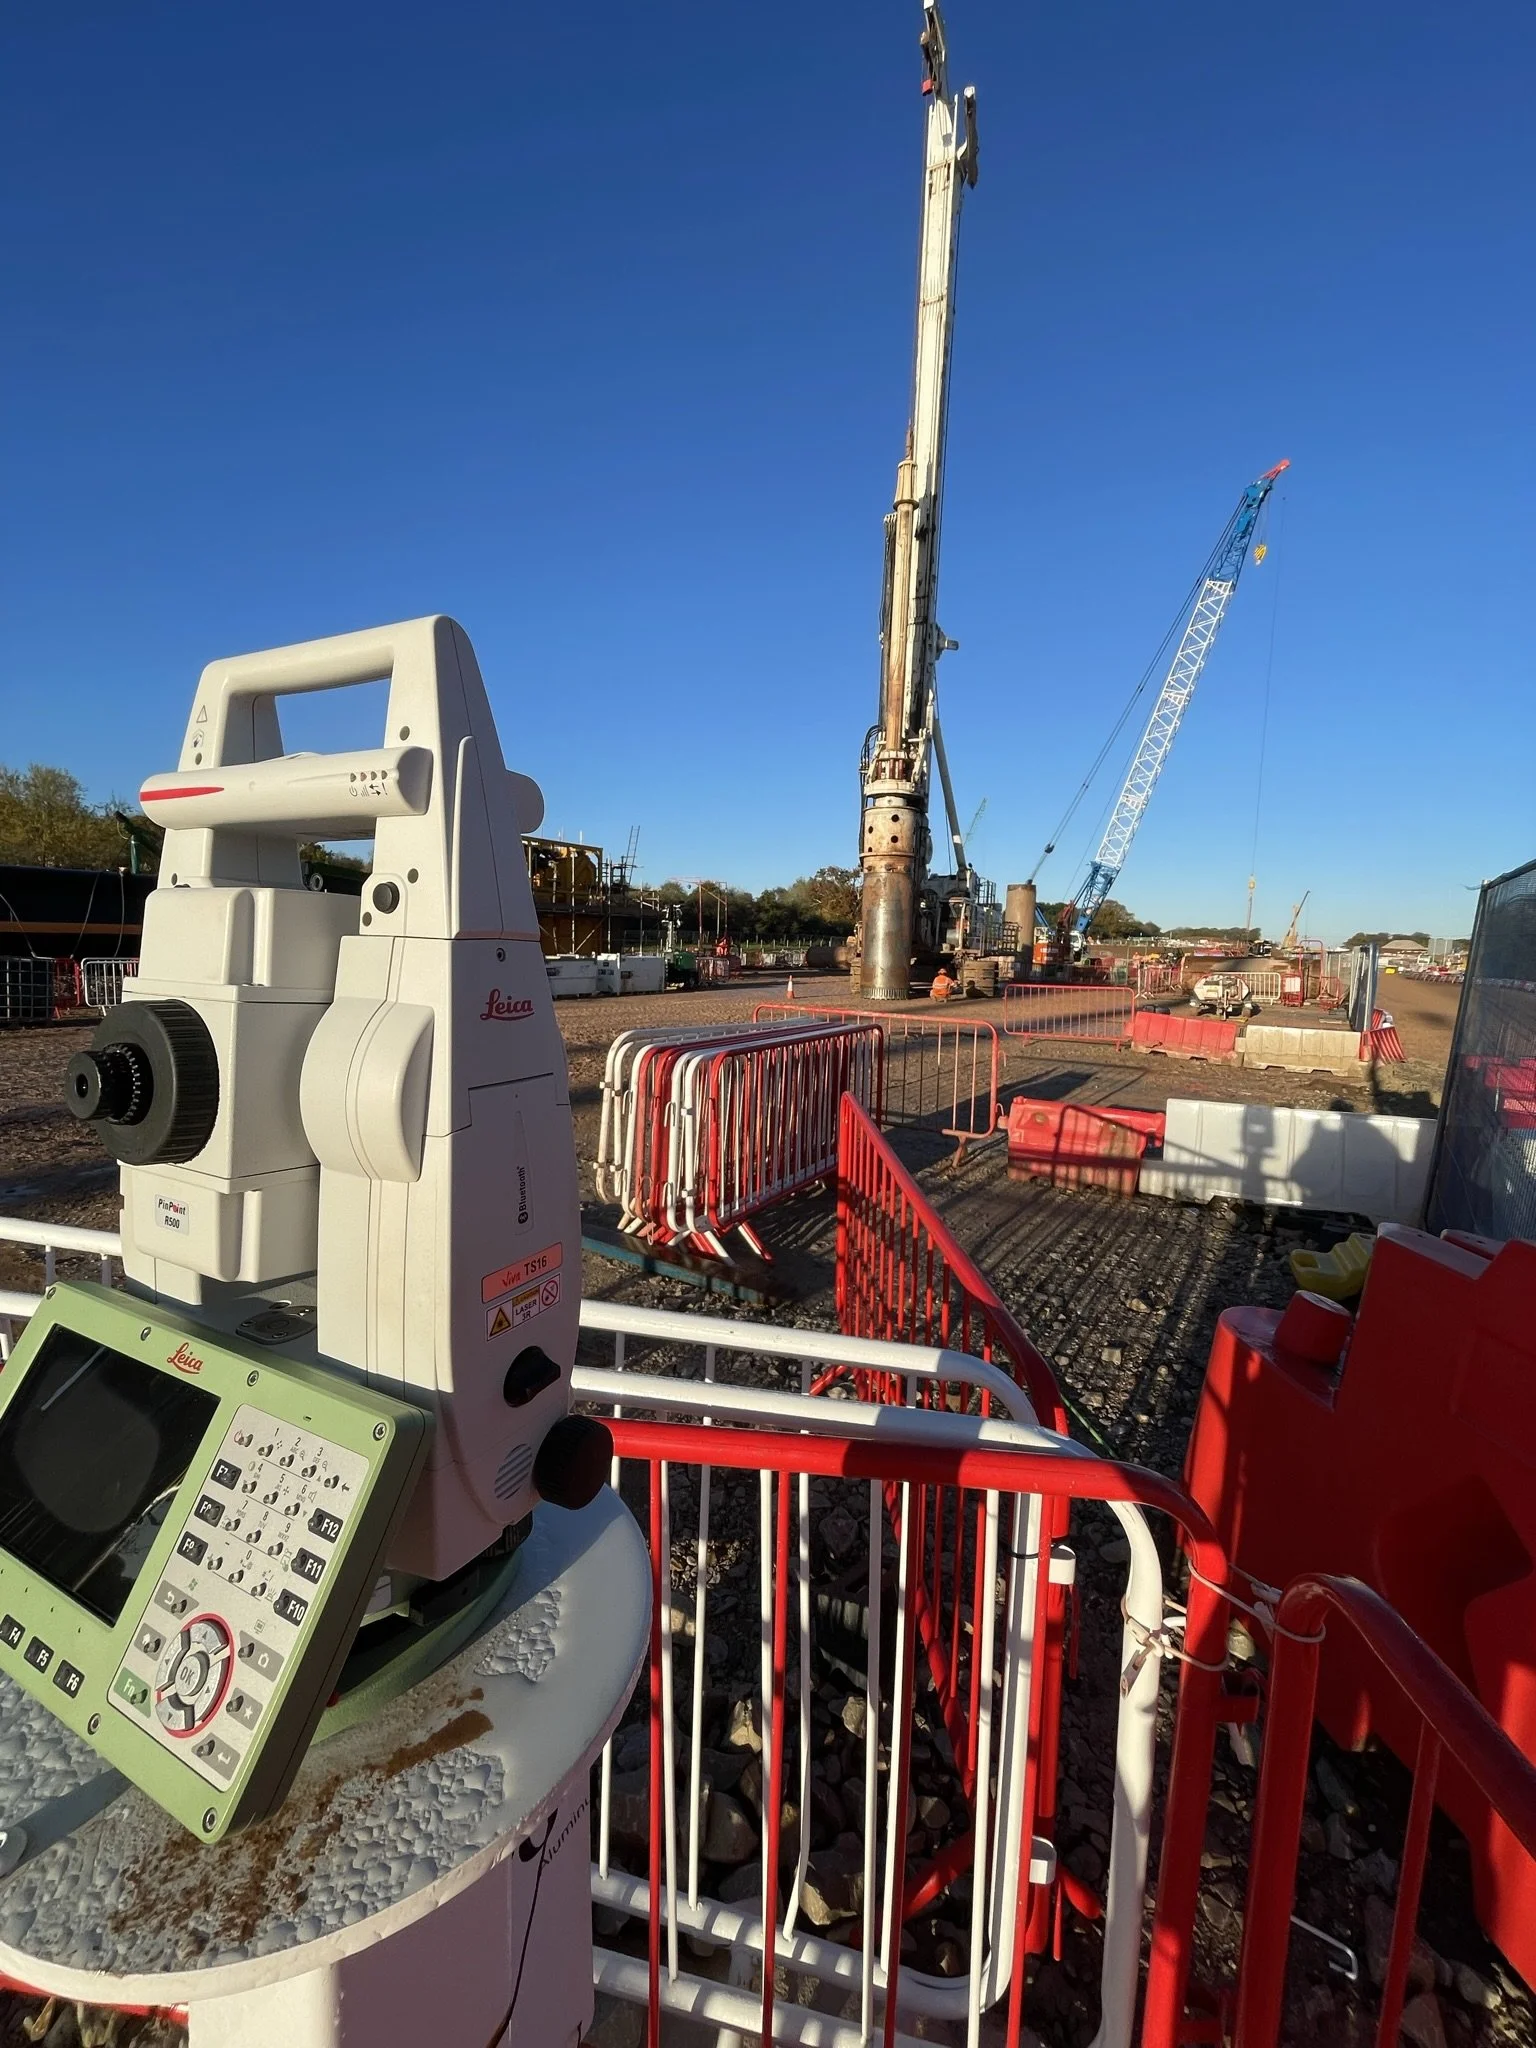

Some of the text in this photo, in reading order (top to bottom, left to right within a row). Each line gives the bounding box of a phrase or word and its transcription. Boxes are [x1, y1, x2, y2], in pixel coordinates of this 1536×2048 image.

[480, 989, 535, 1021] Leica
[518, 1167, 527, 1212] Bluetooth
[158, 1198, 186, 1215] PinPoint
[164, 1215, 180, 1229] R500
[524, 1255, 547, 1276] TS16
[515, 1299, 537, 1316] LASER
[167, 1342, 203, 1374] Leica
[294, 1437, 302, 1447] 2
[316, 1447, 324, 1457] 3
[215, 1464, 229, 1478] F7
[257, 1463, 308, 1494] 4 5 6
[242, 1500, 291, 1533] 7 8 9
[320, 1518, 339, 1538] F12
[182, 1537, 195, 1552] F9
[246, 1549, 253, 1560] 0
[304, 1558, 323, 1579] F11
[287, 1599, 305, 1621] F10
[8, 1626, 21, 1644] F4
[36, 1649, 50, 1667] F5
[66, 1672, 80, 1691] F6
[179, 1666, 195, 1685] OK
[123, 1678, 136, 1697] Fn
[539, 1797, 589, 1870] Alumin
